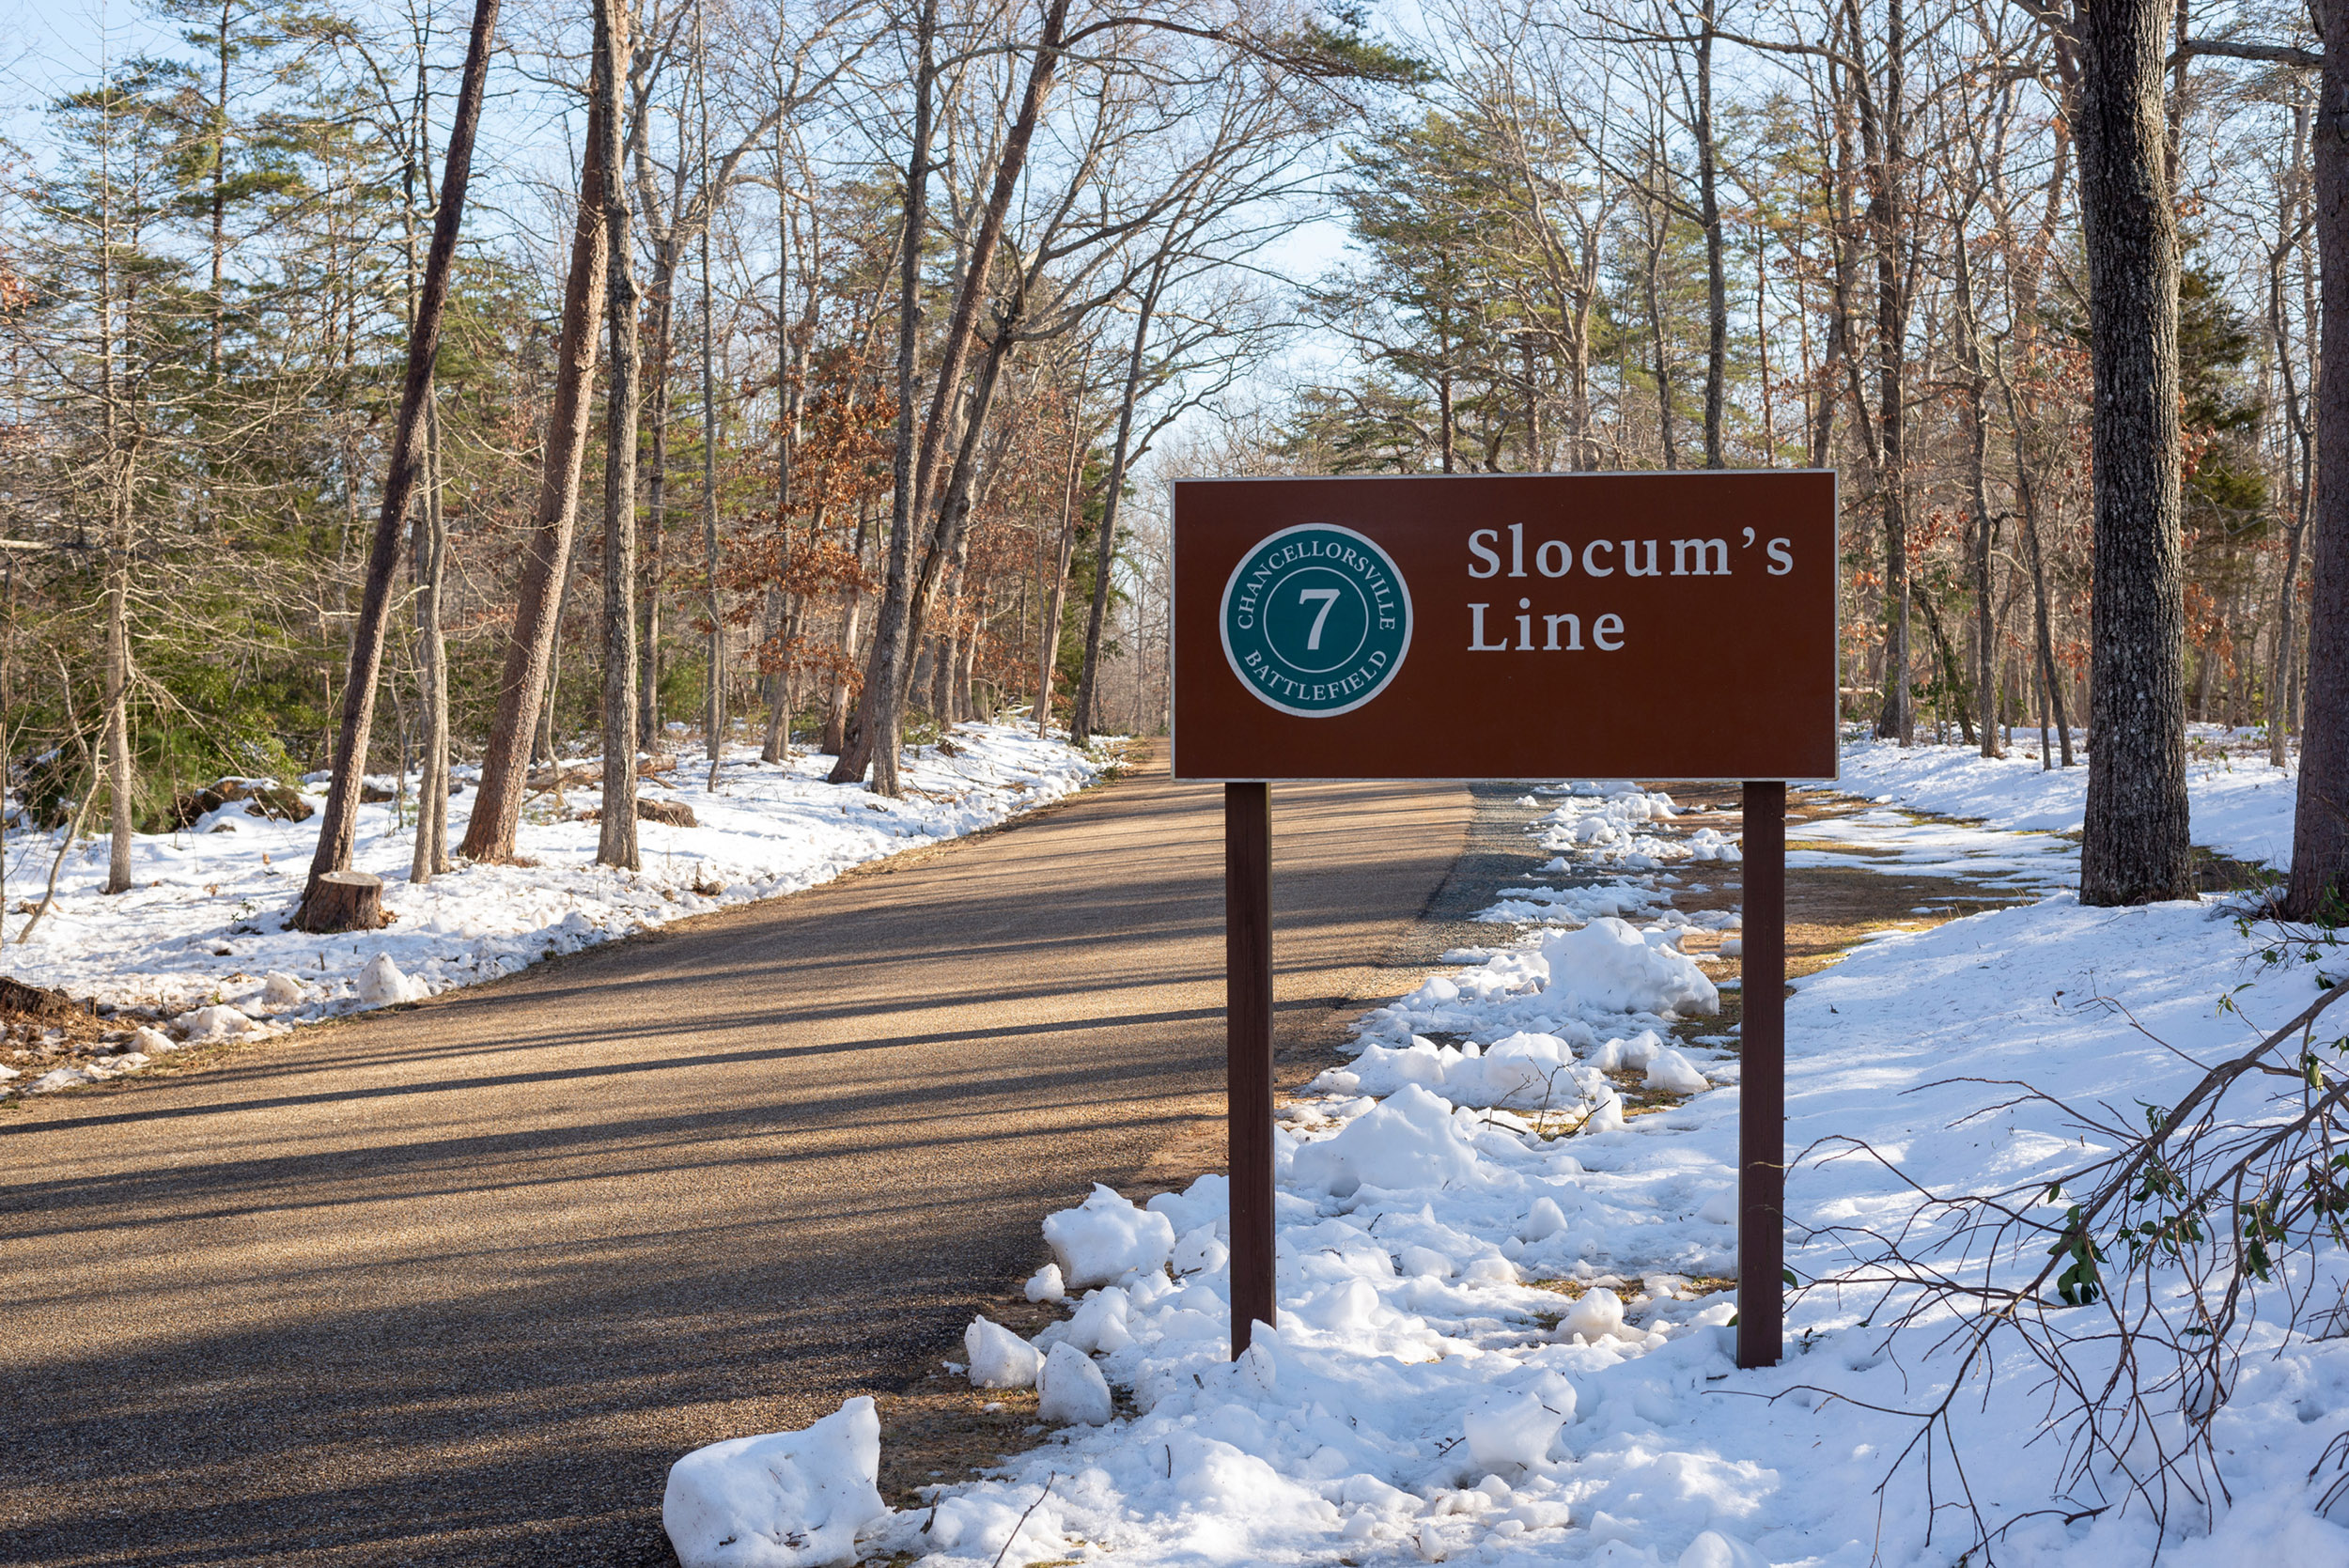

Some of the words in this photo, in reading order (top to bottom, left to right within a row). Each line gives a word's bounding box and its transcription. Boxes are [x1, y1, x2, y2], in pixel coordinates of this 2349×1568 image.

[1468, 523, 1793, 579] Slocum's
[1237, 540, 1395, 630] CHANCELLORSVILLE
[1298, 588, 1342, 650] 7
[1468, 598, 1625, 651] Line
[1244, 649, 1387, 701] BATTLEFIELD
